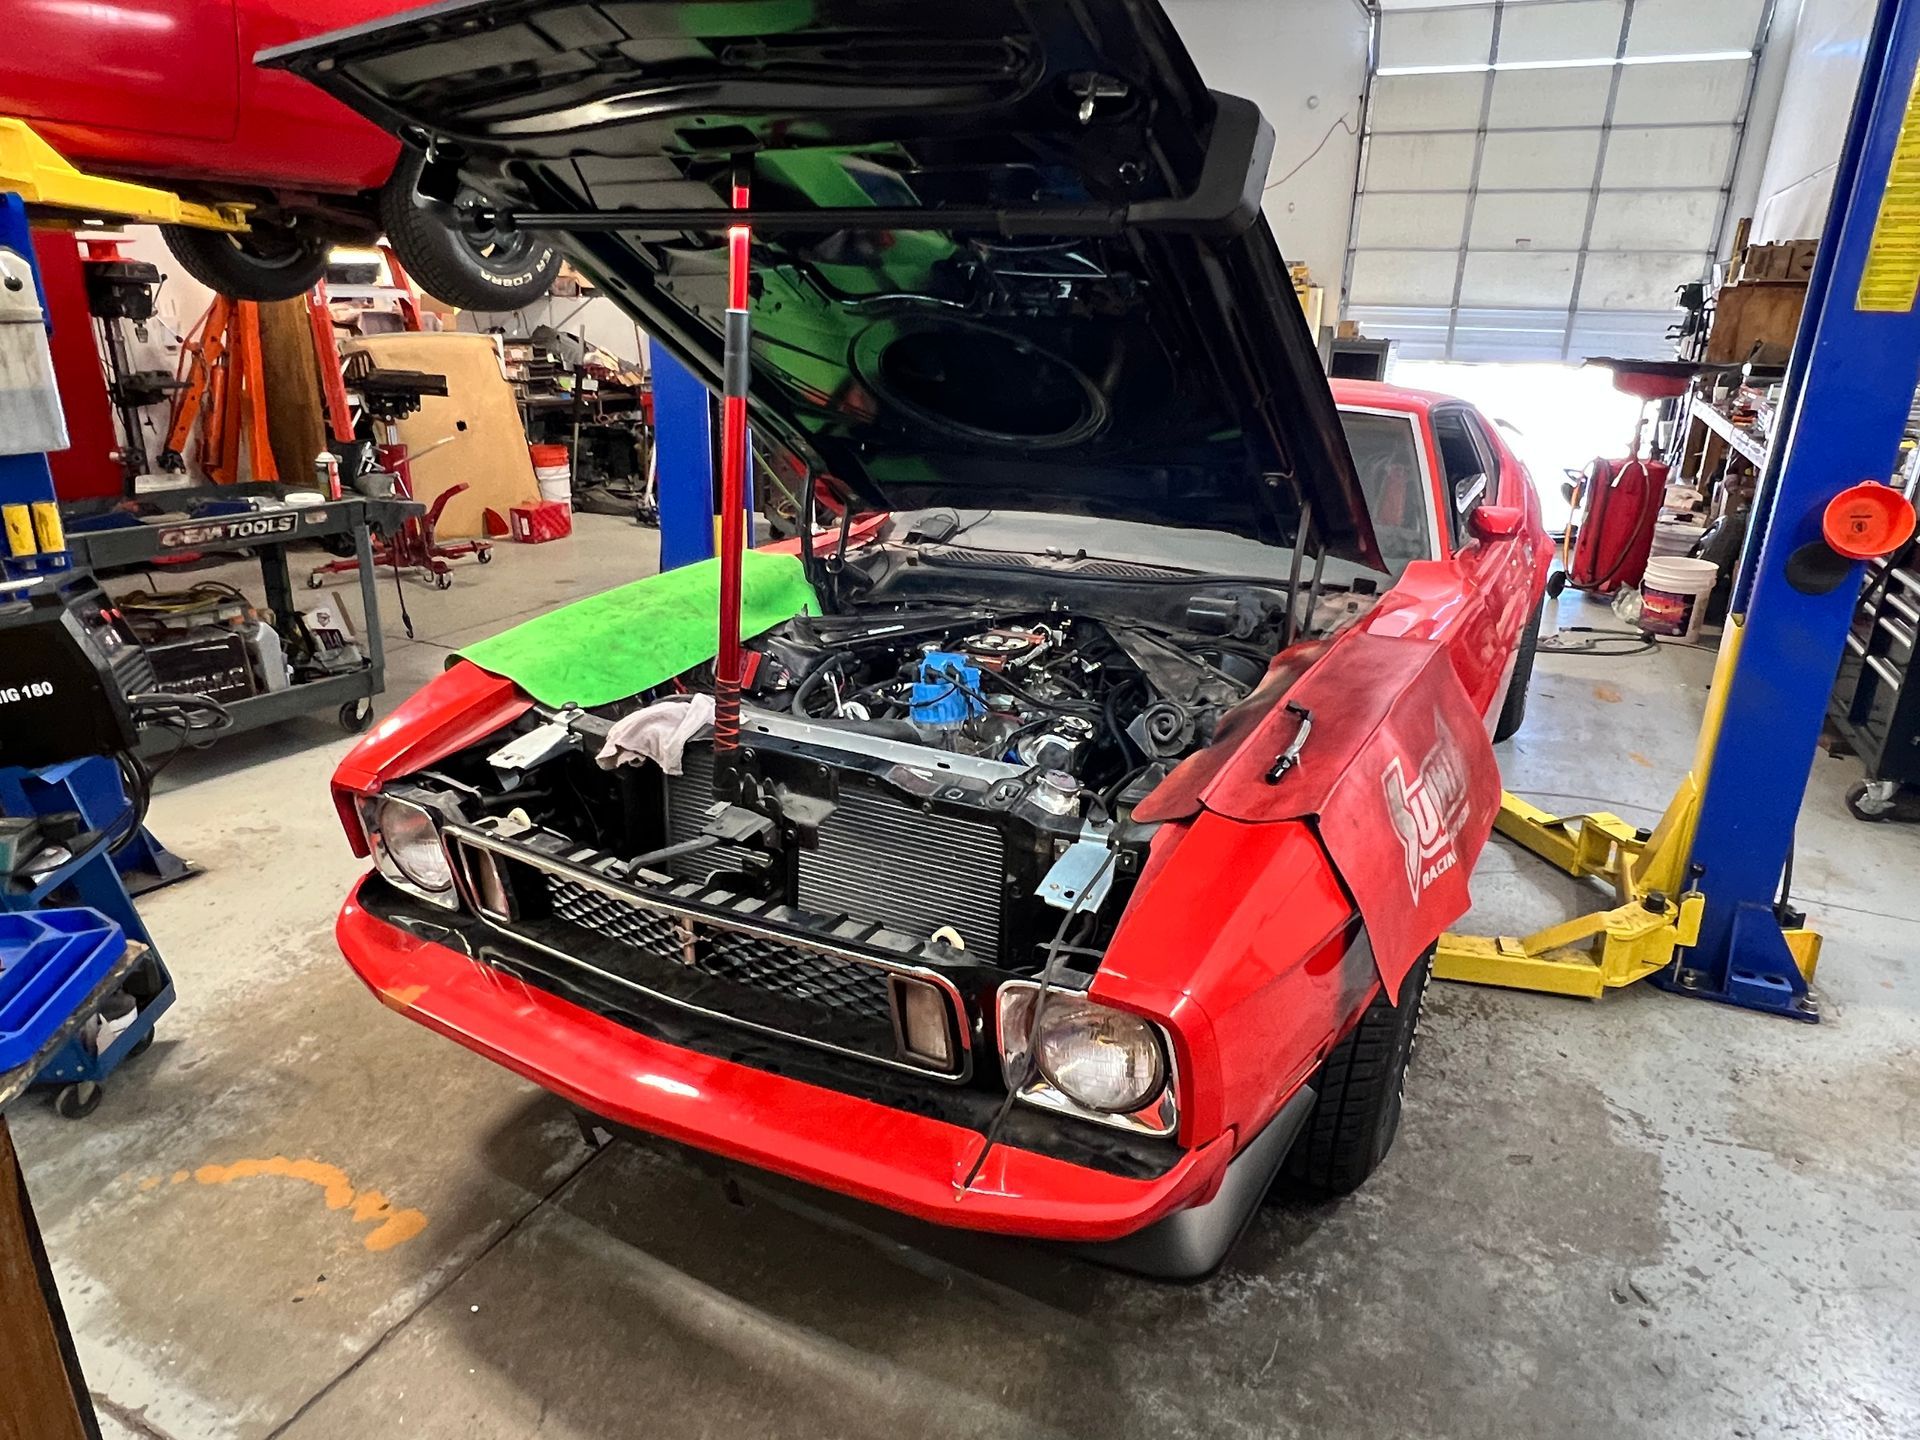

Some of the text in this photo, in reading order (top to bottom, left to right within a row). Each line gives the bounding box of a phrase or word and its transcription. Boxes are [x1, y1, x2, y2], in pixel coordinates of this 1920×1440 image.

[480, 270, 533, 287] COBRA
[226, 516, 294, 538] TOOLS
[0, 681, 54, 704] IG 180
